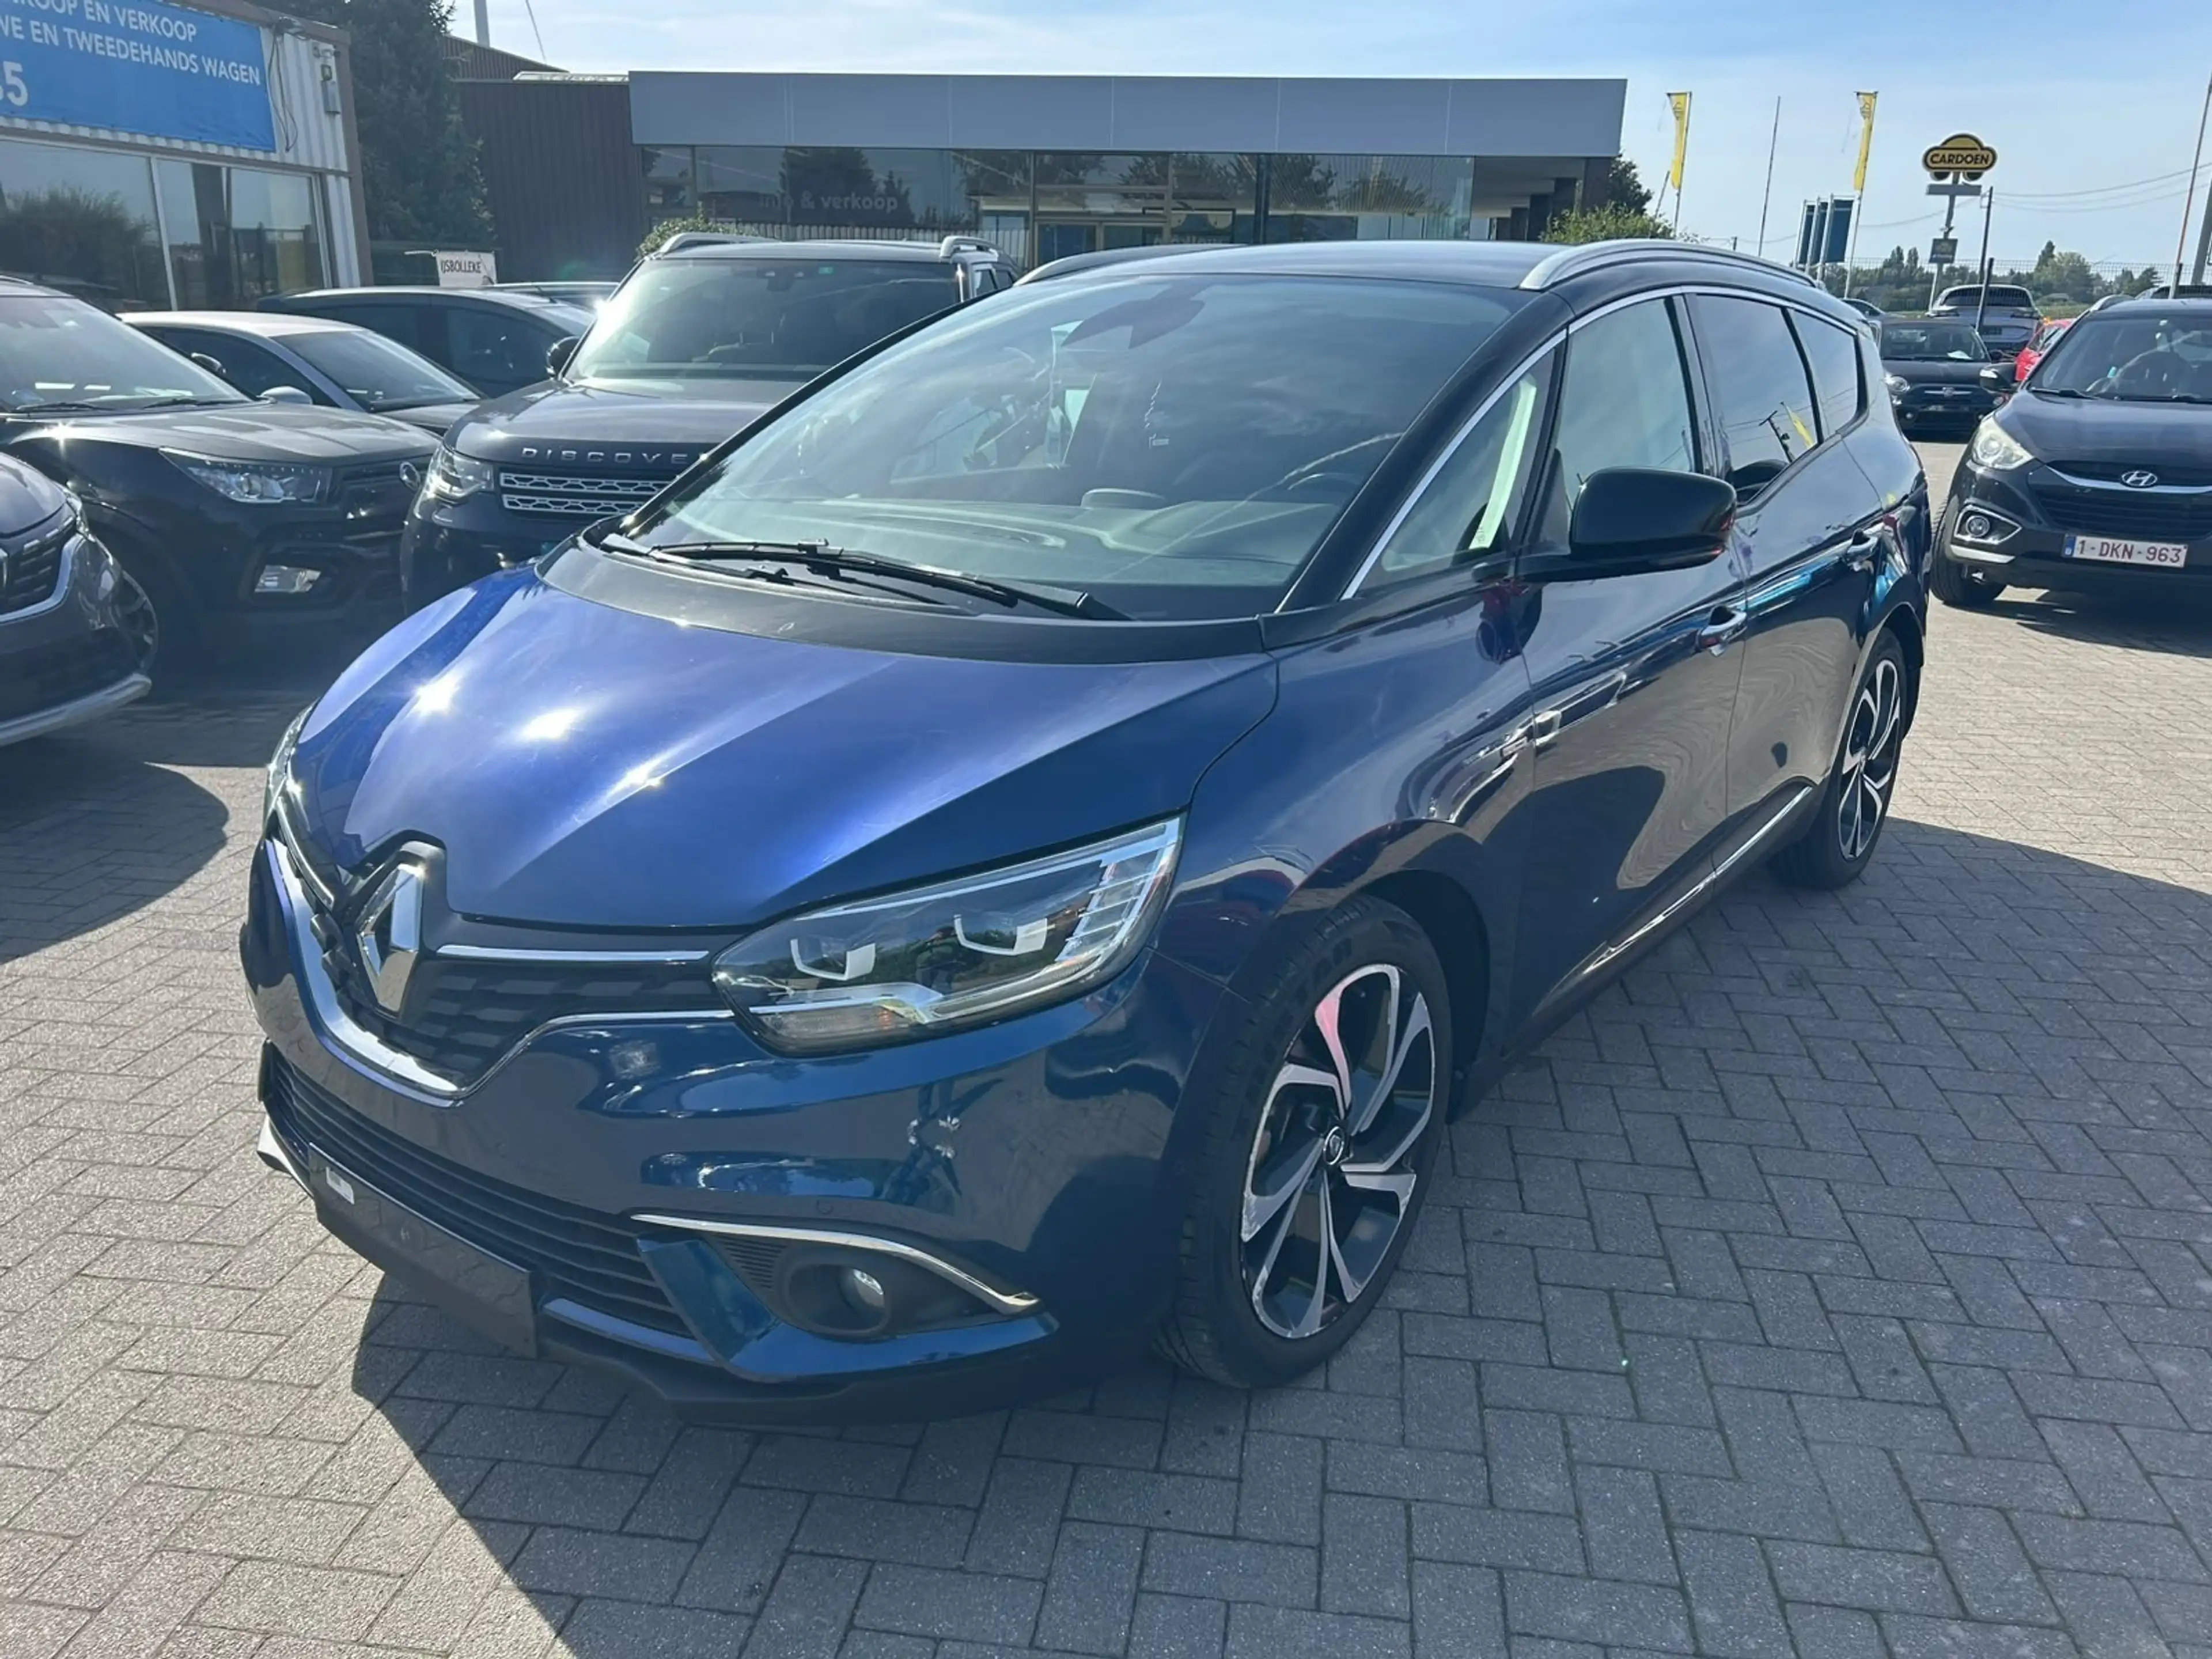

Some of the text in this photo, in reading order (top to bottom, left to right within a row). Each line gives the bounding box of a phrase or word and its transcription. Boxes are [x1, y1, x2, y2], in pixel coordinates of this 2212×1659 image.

[12, 0, 197, 43] OOP EN VERKOOP
[30, 21, 59, 46] EN
[63, 26, 199, 74] TWEEDEHANDS
[202, 55, 261, 86] WAGEN
[0, 60, 28, 107] 5
[1930, 154, 1990, 165] CARDOEN
[820, 192, 898, 213] verkoop
